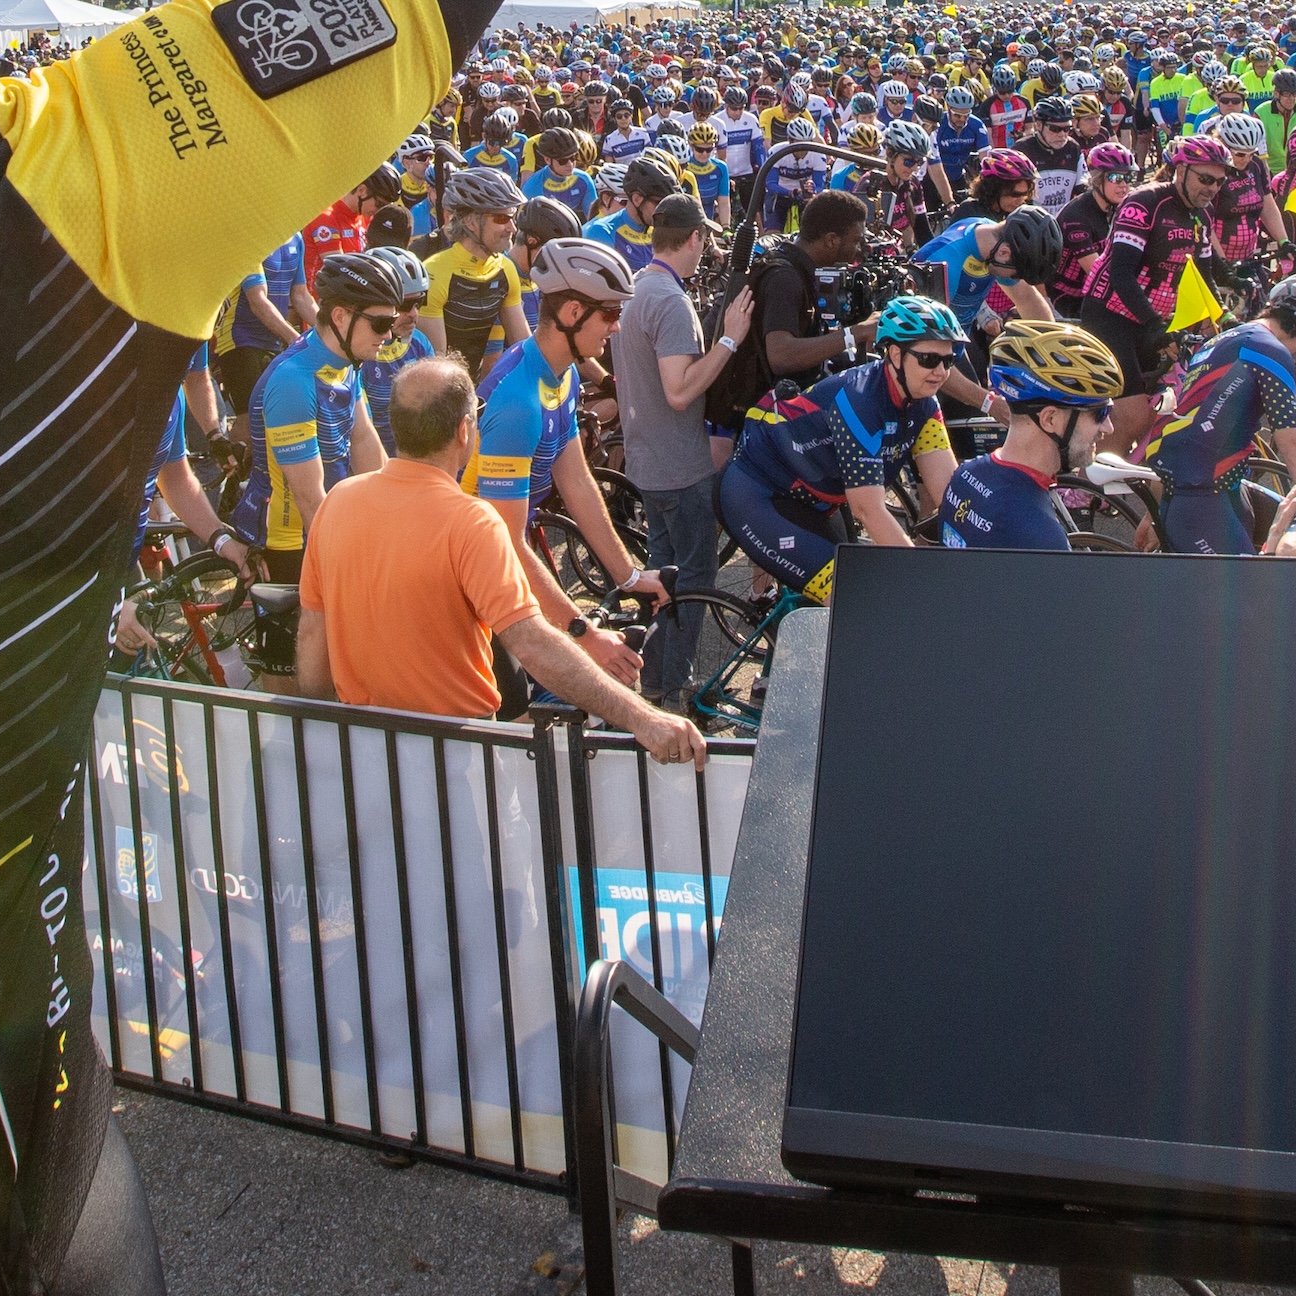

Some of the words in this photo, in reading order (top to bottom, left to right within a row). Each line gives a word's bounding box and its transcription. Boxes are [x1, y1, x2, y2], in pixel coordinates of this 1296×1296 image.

[120, 31, 173, 108] Princess
[155, 34, 228, 150] Margaret
[162, 105, 198, 160] The
[1037, 176, 1070, 189] STEVE'S
[1228, 177, 1256, 191] STEVE'S
[1119, 205, 1149, 224] FOX
[347, 271, 368, 286] GIRO
[1209, 376, 1245, 421] FIERACAPITAL
[966, 473, 986, 495] YEARS
[984, 489, 993, 498] OF
[966, 509, 993, 533] INNES
[741, 523, 807, 579] FIERACAPITAL
